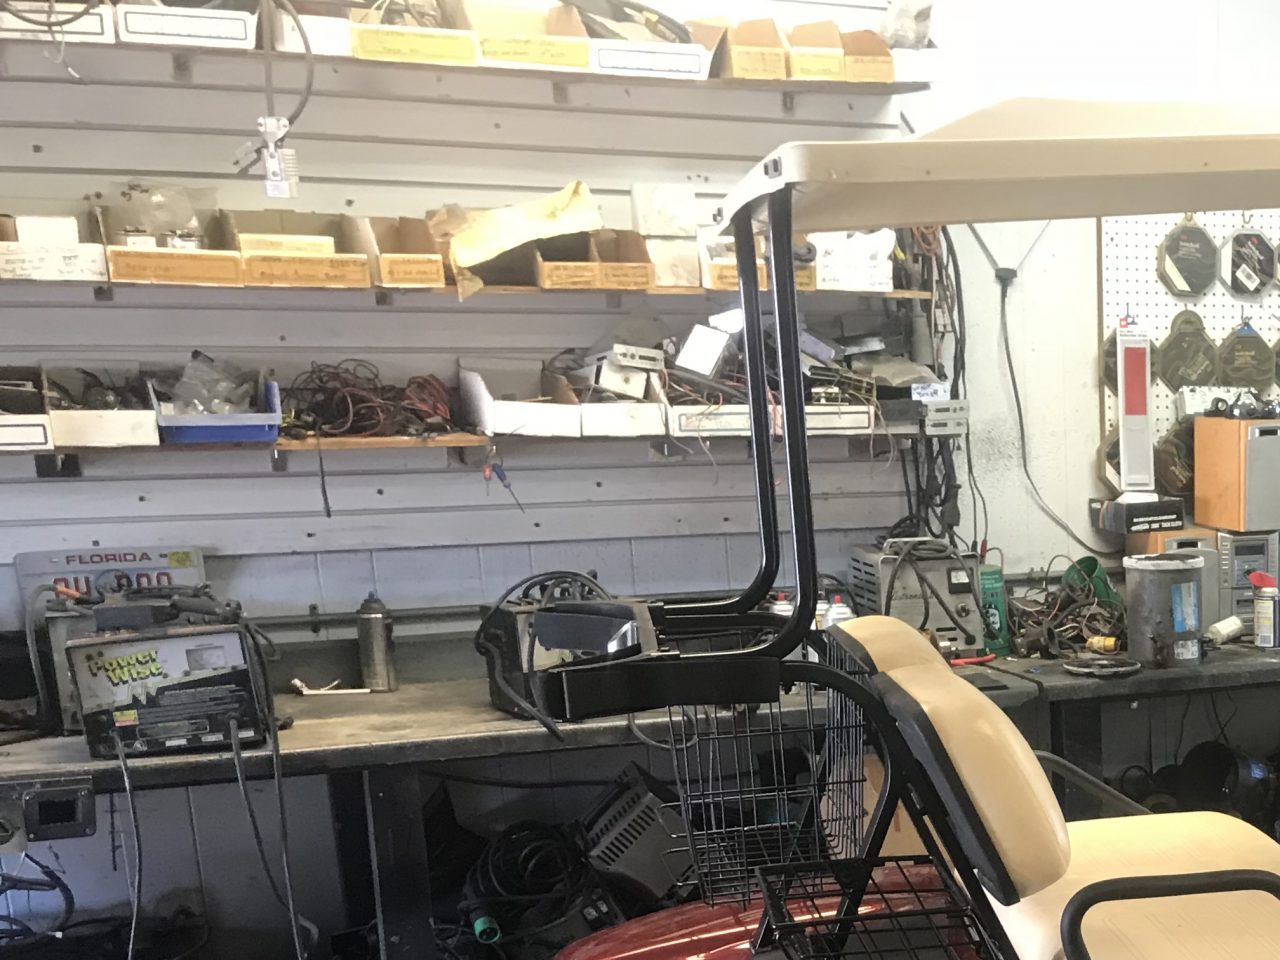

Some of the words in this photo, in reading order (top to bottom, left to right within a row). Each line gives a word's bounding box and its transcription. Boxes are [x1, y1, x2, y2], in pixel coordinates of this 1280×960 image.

[65, 552, 152, 565] FLORIDA
[89, 649, 157, 677] Power
[107, 662, 163, 686] Wise
